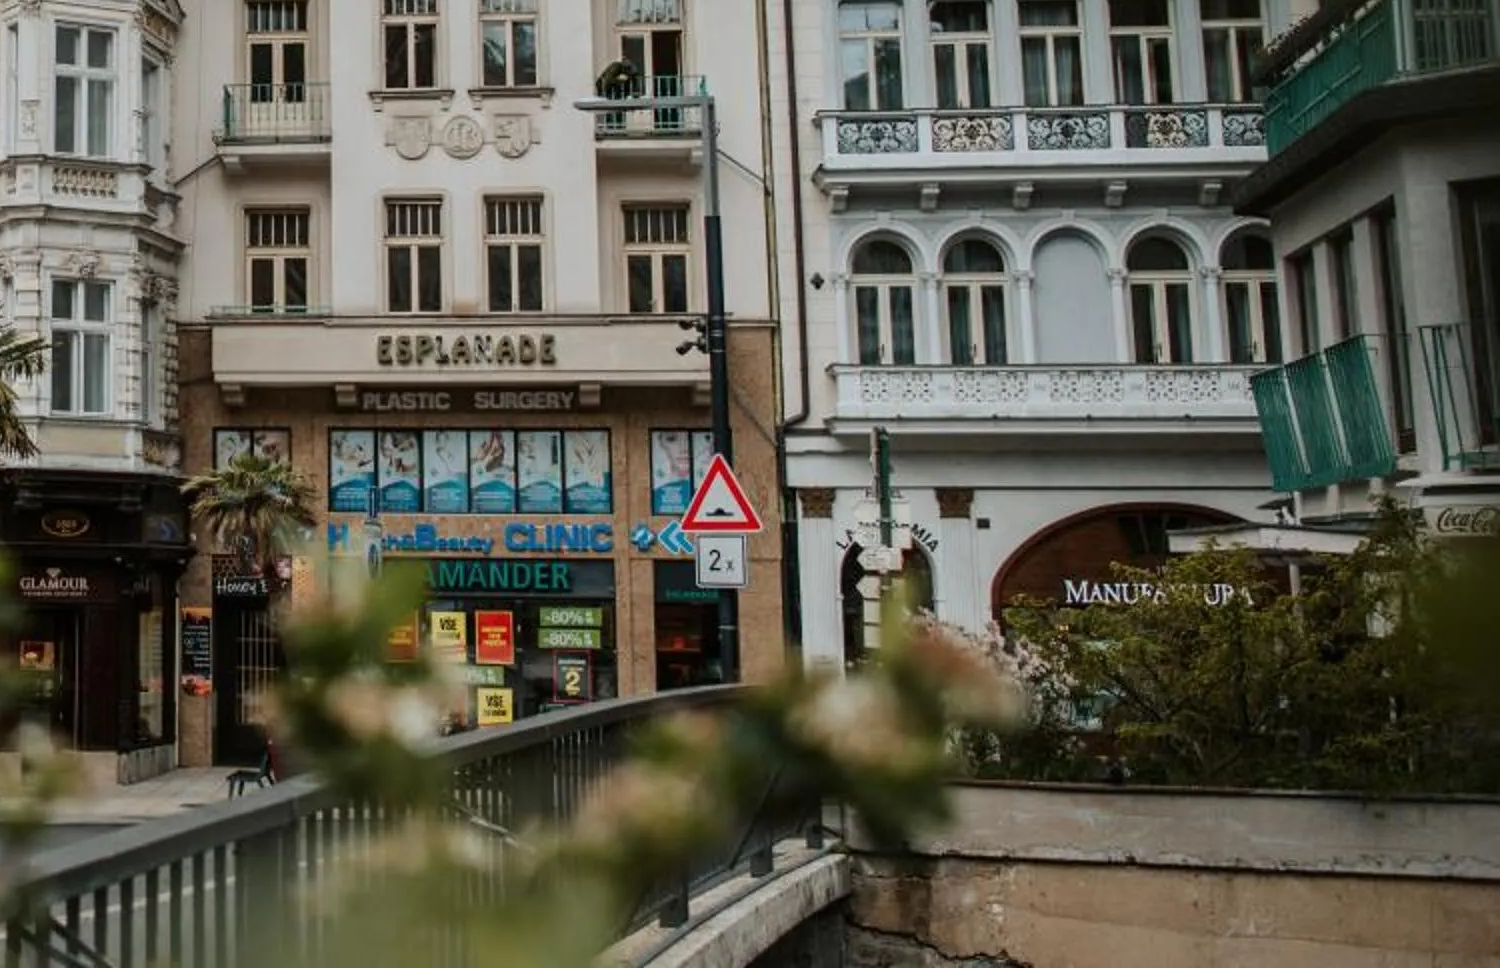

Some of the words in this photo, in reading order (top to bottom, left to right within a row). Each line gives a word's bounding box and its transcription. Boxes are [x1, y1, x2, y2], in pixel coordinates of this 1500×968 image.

[377, 334, 556, 366] ESPLANADE
[363, 392, 451, 410] PLASTIC
[474, 391, 574, 410] SURGERY
[504, 521, 613, 553] CLINIC
[20, 577, 89, 590] GLAMOUR
[426, 562, 569, 589] AMANDER
